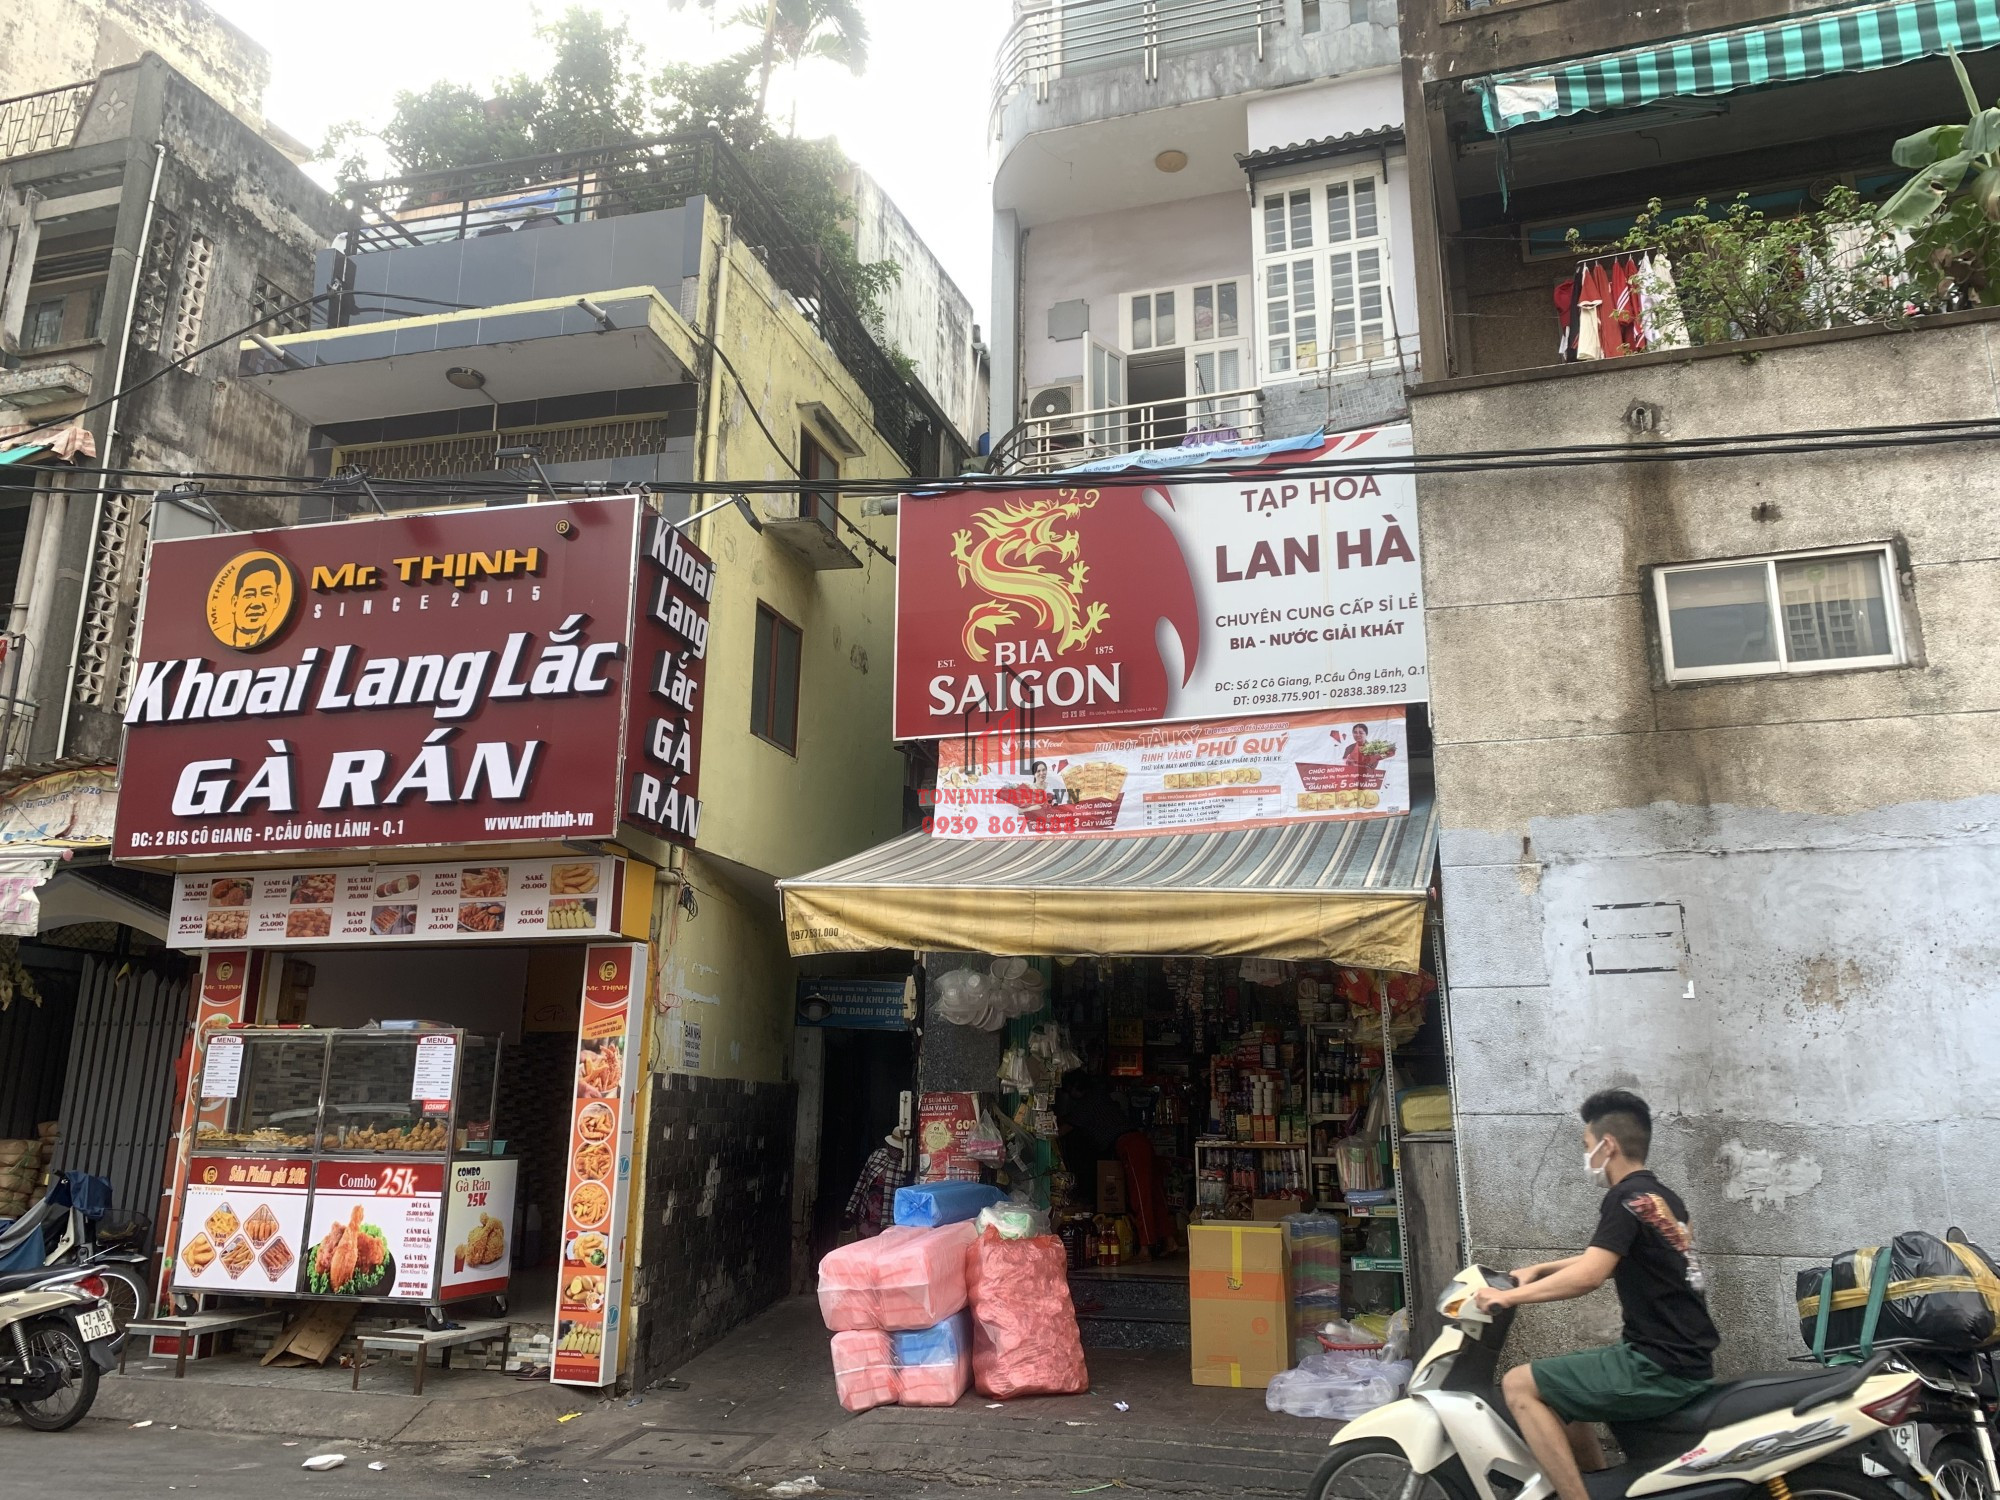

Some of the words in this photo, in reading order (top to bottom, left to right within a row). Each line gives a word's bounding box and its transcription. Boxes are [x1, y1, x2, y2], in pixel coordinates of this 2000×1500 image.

[1241, 485, 1298, 517] TẠP
[651, 520, 716, 603] Khoai
[1216, 534, 1320, 583] LAN
[1337, 514, 1415, 569] HÀ
[311, 562, 377, 590] Mr.
[393, 547, 538, 587] THỊNH
[211, 565, 236, 602] THỊNH
[313, 594, 430, 619] SINCE
[451, 586, 541, 608] 2015
[1215, 608, 1281, 627] CHUYÊN
[1286, 604, 1335, 621] CUNG
[1339, 598, 1373, 615] CẤP
[1379, 595, 1393, 612] SỈ
[1399, 592, 1418, 610] LẺ
[656, 576, 710, 660] Lang
[1230, 637, 1256, 650] BIA
[1270, 627, 1318, 646] NƯỚC
[1323, 624, 1356, 641] GIẢI
[1361, 619, 1404, 638] KHÁT
[937, 660, 956, 668] EST.
[994, 638, 1053, 667] BIA
[1095, 646, 1114, 655] 1875
[123, 647, 319, 724] Khoai
[316, 644, 490, 721] Lang
[488, 613, 618, 698] Lắc
[659, 651, 697, 712] Lắc
[1215, 682, 1234, 692] ĐC:
[1236, 677, 1251, 690] Số
[1252, 680, 1258, 689] 2
[1260, 678, 1275, 688] Cô
[1278, 676, 1312, 690] Giang,
[1315, 671, 1345, 684] P.Cầu
[1348, 669, 1371, 683] Ông
[1374, 667, 1404, 680] Lãnh,
[1408, 665, 1425, 677] Q.1
[929, 662, 1121, 716] SAIGON
[1233, 696, 1250, 706] ĐT:
[1252, 691, 1320, 705] 0938.775.901
[1330, 683, 1407, 698] 02838.389.123
[653, 718, 691, 774] GÀ
[1095, 742, 1118, 753] MUA
[1118, 740, 1137, 752] BỘT
[1139, 728, 1170, 749] TÀI
[1170, 724, 1202, 746] KÝ
[1141, 753, 1163, 762] RINH
[1167, 750, 1191, 760] VÀNG
[1196, 736, 1238, 758] PHÚ
[1243, 732, 1289, 754] QUÝ
[171, 739, 293, 816] GÀ
[318, 727, 540, 808] RÁN
[1340, 780, 1347, 788] 5
[638, 773, 702, 840] RÁN
[131, 833, 152, 848] ĐC:
[155, 831, 164, 846] 2
[166, 830, 188, 846] BIS
[191, 825, 209, 845] CÔ
[211, 827, 252, 844] GIANG
[264, 819, 301, 842] P.CẦU
[304, 820, 331, 840] ÔNG
[334, 819, 370, 838] LÃNH
[382, 820, 404, 837] Q.1
[1074, 818, 1080, 827] 3
[602, 984, 628, 992] THỊNH
[846, 994, 863, 1003] DÂN
[866, 996, 883, 1004] KHU
[849, 1007, 873, 1016] DANH
[876, 1007, 896, 1017] HIỆU
[339, 1173, 377, 1189] Combo
[376, 1167, 417, 1196] 25k
[456, 1179, 469, 1193] Gà
[472, 1178, 490, 1191] Rán
[457, 1167, 481, 1177] COMBO
[467, 1193, 487, 1207] 25K
[83, 1310, 106, 1327] 47-AB
[84, 1320, 114, 1340] 120.35
